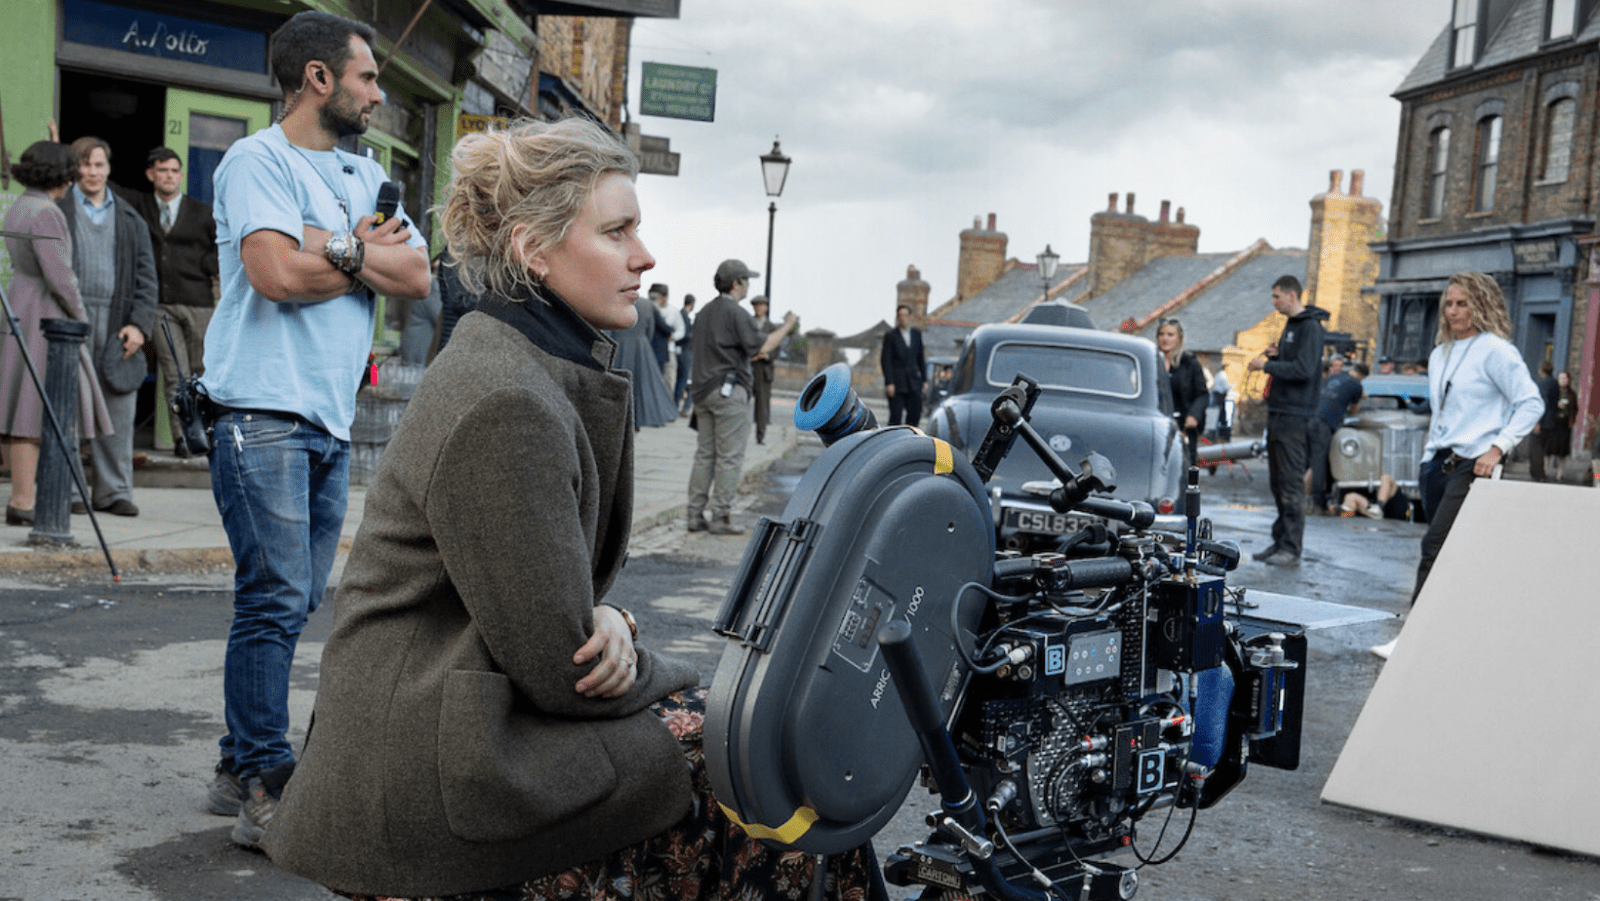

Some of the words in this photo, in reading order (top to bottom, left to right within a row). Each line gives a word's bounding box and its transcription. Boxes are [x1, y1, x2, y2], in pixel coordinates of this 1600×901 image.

[168, 119, 182, 135] 21
[1049, 650, 1062, 670] B
[1140, 755, 1161, 791] B
